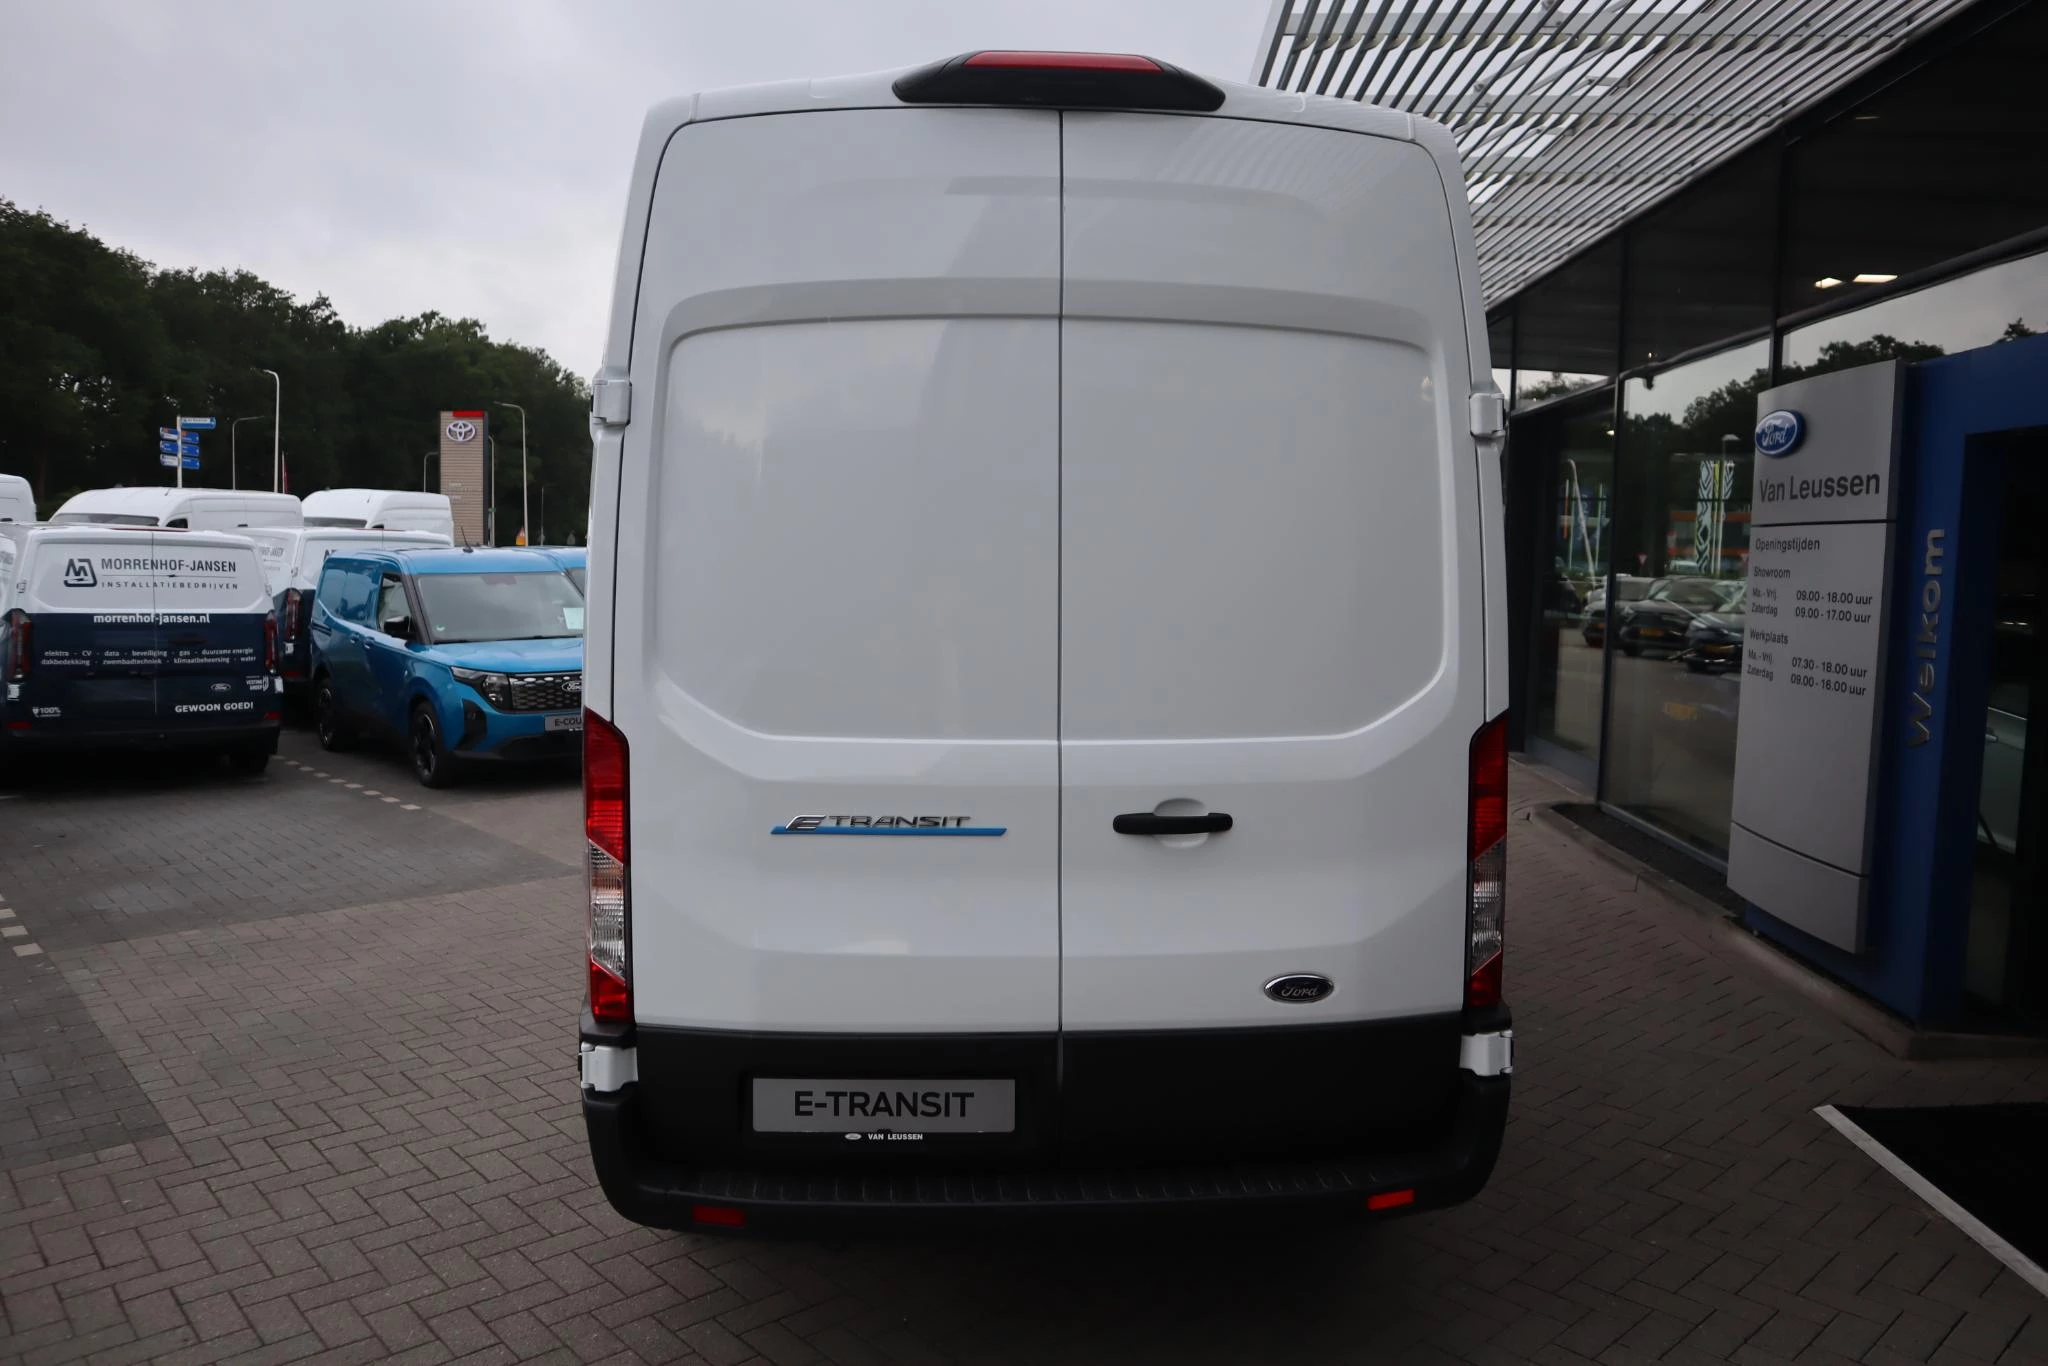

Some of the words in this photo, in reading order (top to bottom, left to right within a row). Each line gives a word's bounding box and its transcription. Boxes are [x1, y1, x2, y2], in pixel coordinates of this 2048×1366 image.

[1760, 479, 1785, 503] Van
[1790, 473, 1880, 500] Leussen
[1755, 538, 1820, 553] Openingstijden
[101, 558, 237, 573] MORRENHOF-JANSEN
[1753, 566, 1791, 579] Showroom
[101, 581, 238, 590] INSTALLATIEBEDRIJVEN
[1796, 590, 1820, 601] 09.00
[1827, 592, 1853, 604] 18.00
[1855, 594, 1873, 605] uur
[93, 613, 210, 625] morrenhof-jansen.nl
[1751, 602, 1778, 617] Zaterdag
[1795, 606, 1819, 618] 09.00
[1827, 609, 1852, 621] 17.00
[1854, 613, 1871, 623] uur
[1749, 628, 1788, 644] Werkplaats
[1907, 527, 1946, 750] Welkom
[41, 658, 91, 666] dakbedekking
[1792, 656, 1815, 670] 07.30
[1821, 661, 1848, 675] 18.00
[1850, 667, 1868, 678] uur
[1790, 673, 1815, 687] 09.00
[1849, 684, 1867, 696] uur
[175, 704, 220, 713] GEWOON
[223, 702, 254, 710] GOED!
[554, 717, 582, 726] E-COU
[794, 1090, 975, 1118] E-TRANSIT
